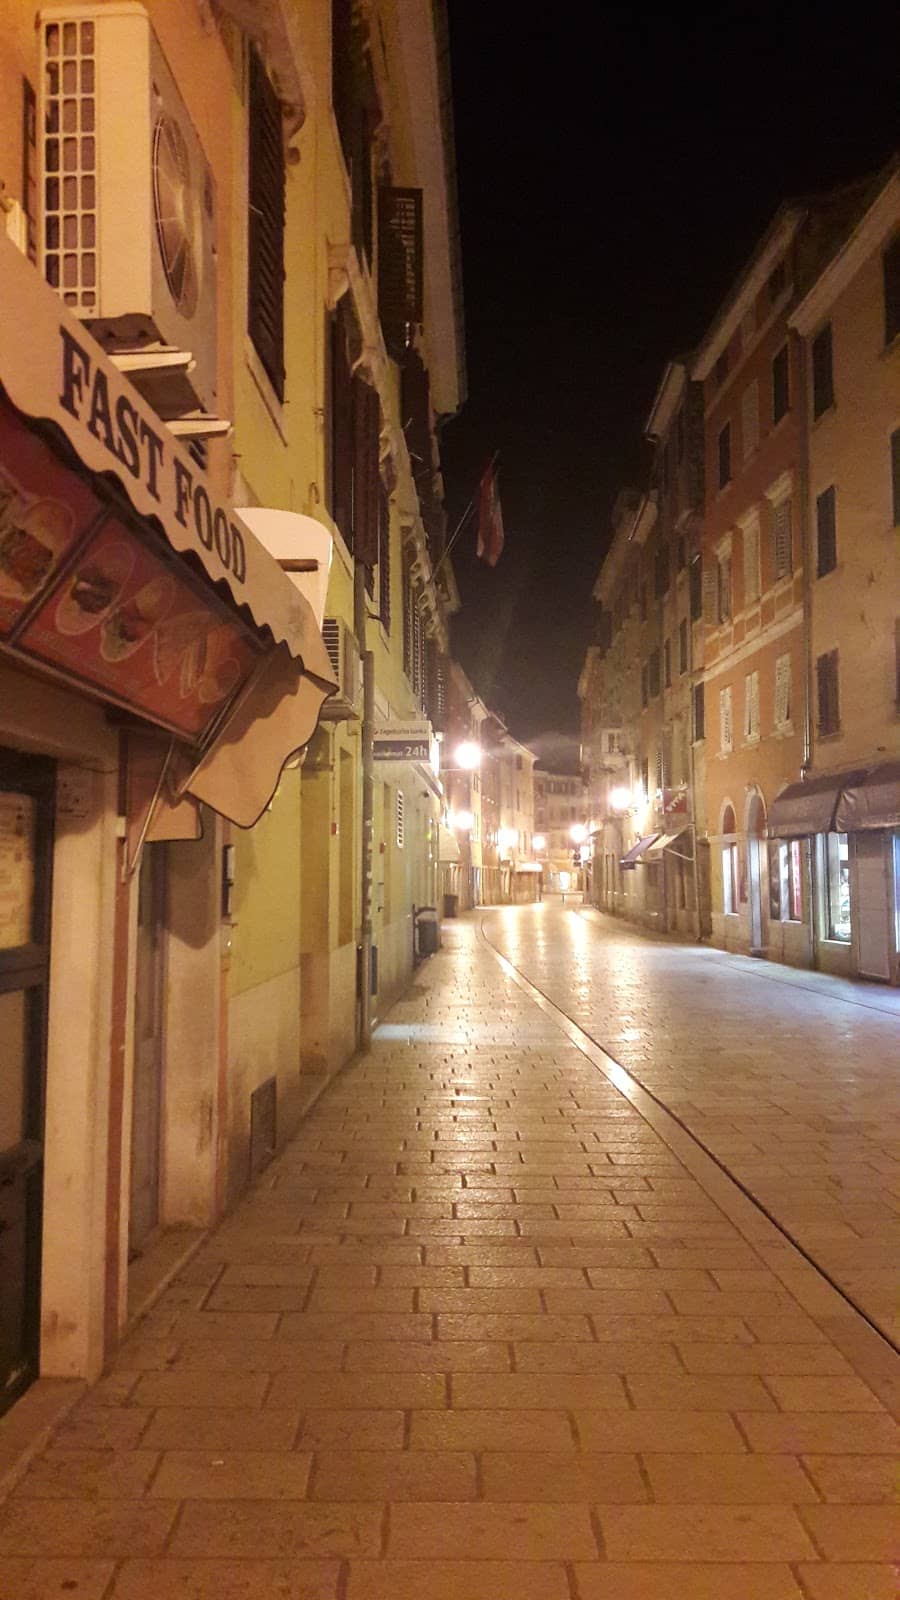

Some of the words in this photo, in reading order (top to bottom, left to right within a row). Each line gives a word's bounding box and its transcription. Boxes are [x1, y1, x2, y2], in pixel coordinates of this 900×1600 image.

[59, 325, 164, 502] FAST
[173, 457, 247, 585] FOOD
[405, 745, 427, 757] 24h
